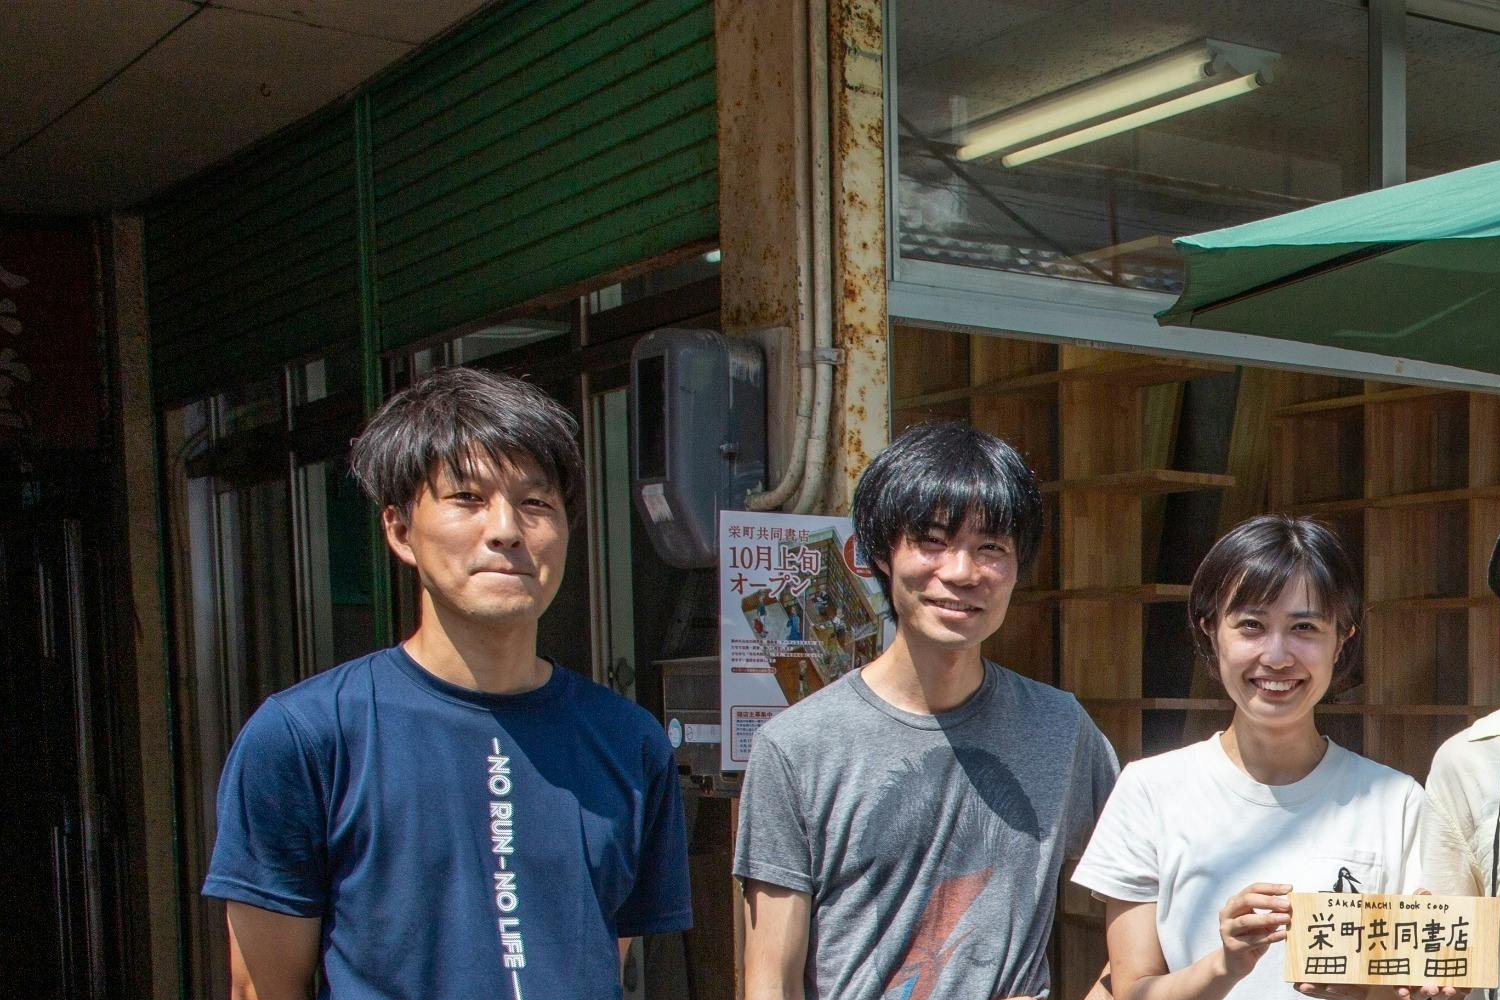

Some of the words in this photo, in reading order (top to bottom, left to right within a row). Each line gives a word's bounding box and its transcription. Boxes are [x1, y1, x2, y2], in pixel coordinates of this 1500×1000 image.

[728, 525, 810, 542] 栄町共同書店
[728, 545, 820, 574] 10月上旬
[729, 573, 810, 597] オープン
[486, 755, 513, 796] NO
[497, 918, 526, 969] LIFE
[1307, 912, 1470, 954] 栄町共同書店
